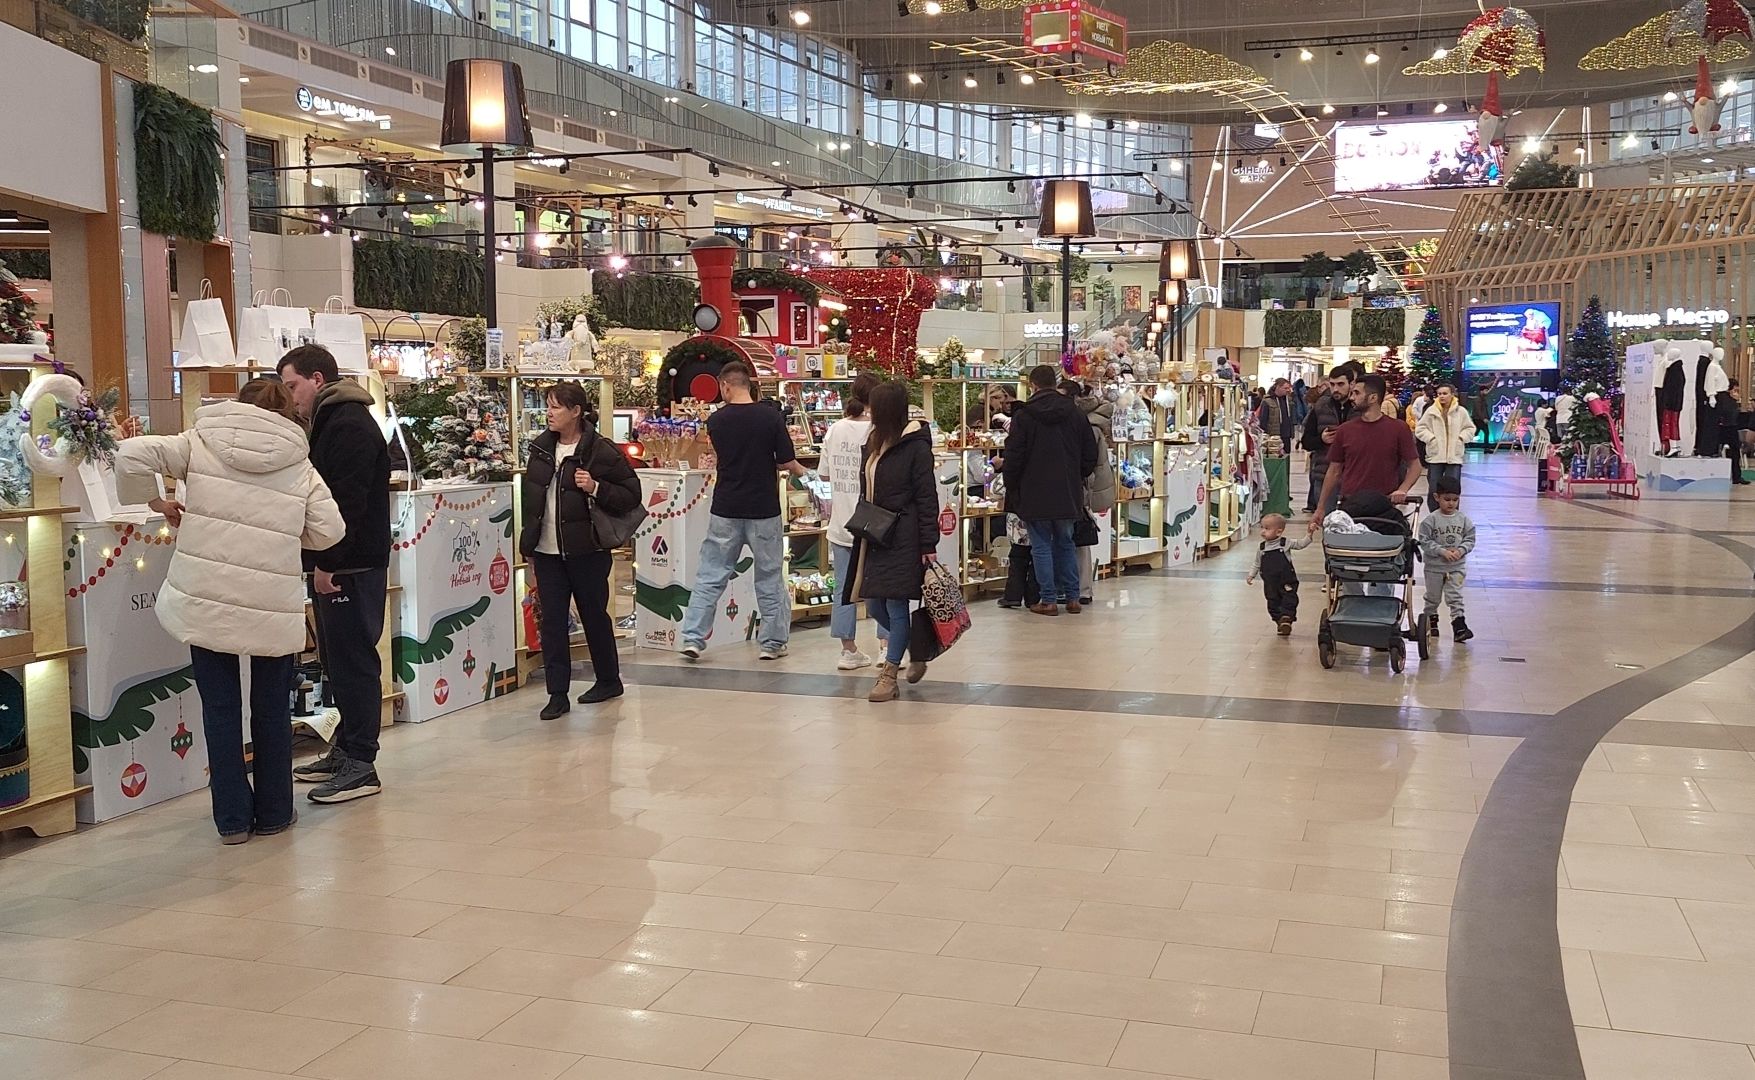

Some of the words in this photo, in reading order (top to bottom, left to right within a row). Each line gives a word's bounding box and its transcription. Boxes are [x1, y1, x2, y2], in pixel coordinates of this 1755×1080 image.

[1232, 166, 1274, 175] СИНЕМА
[1607, 310, 1661, 328] Наше
[1666, 307, 1729, 325] Место
